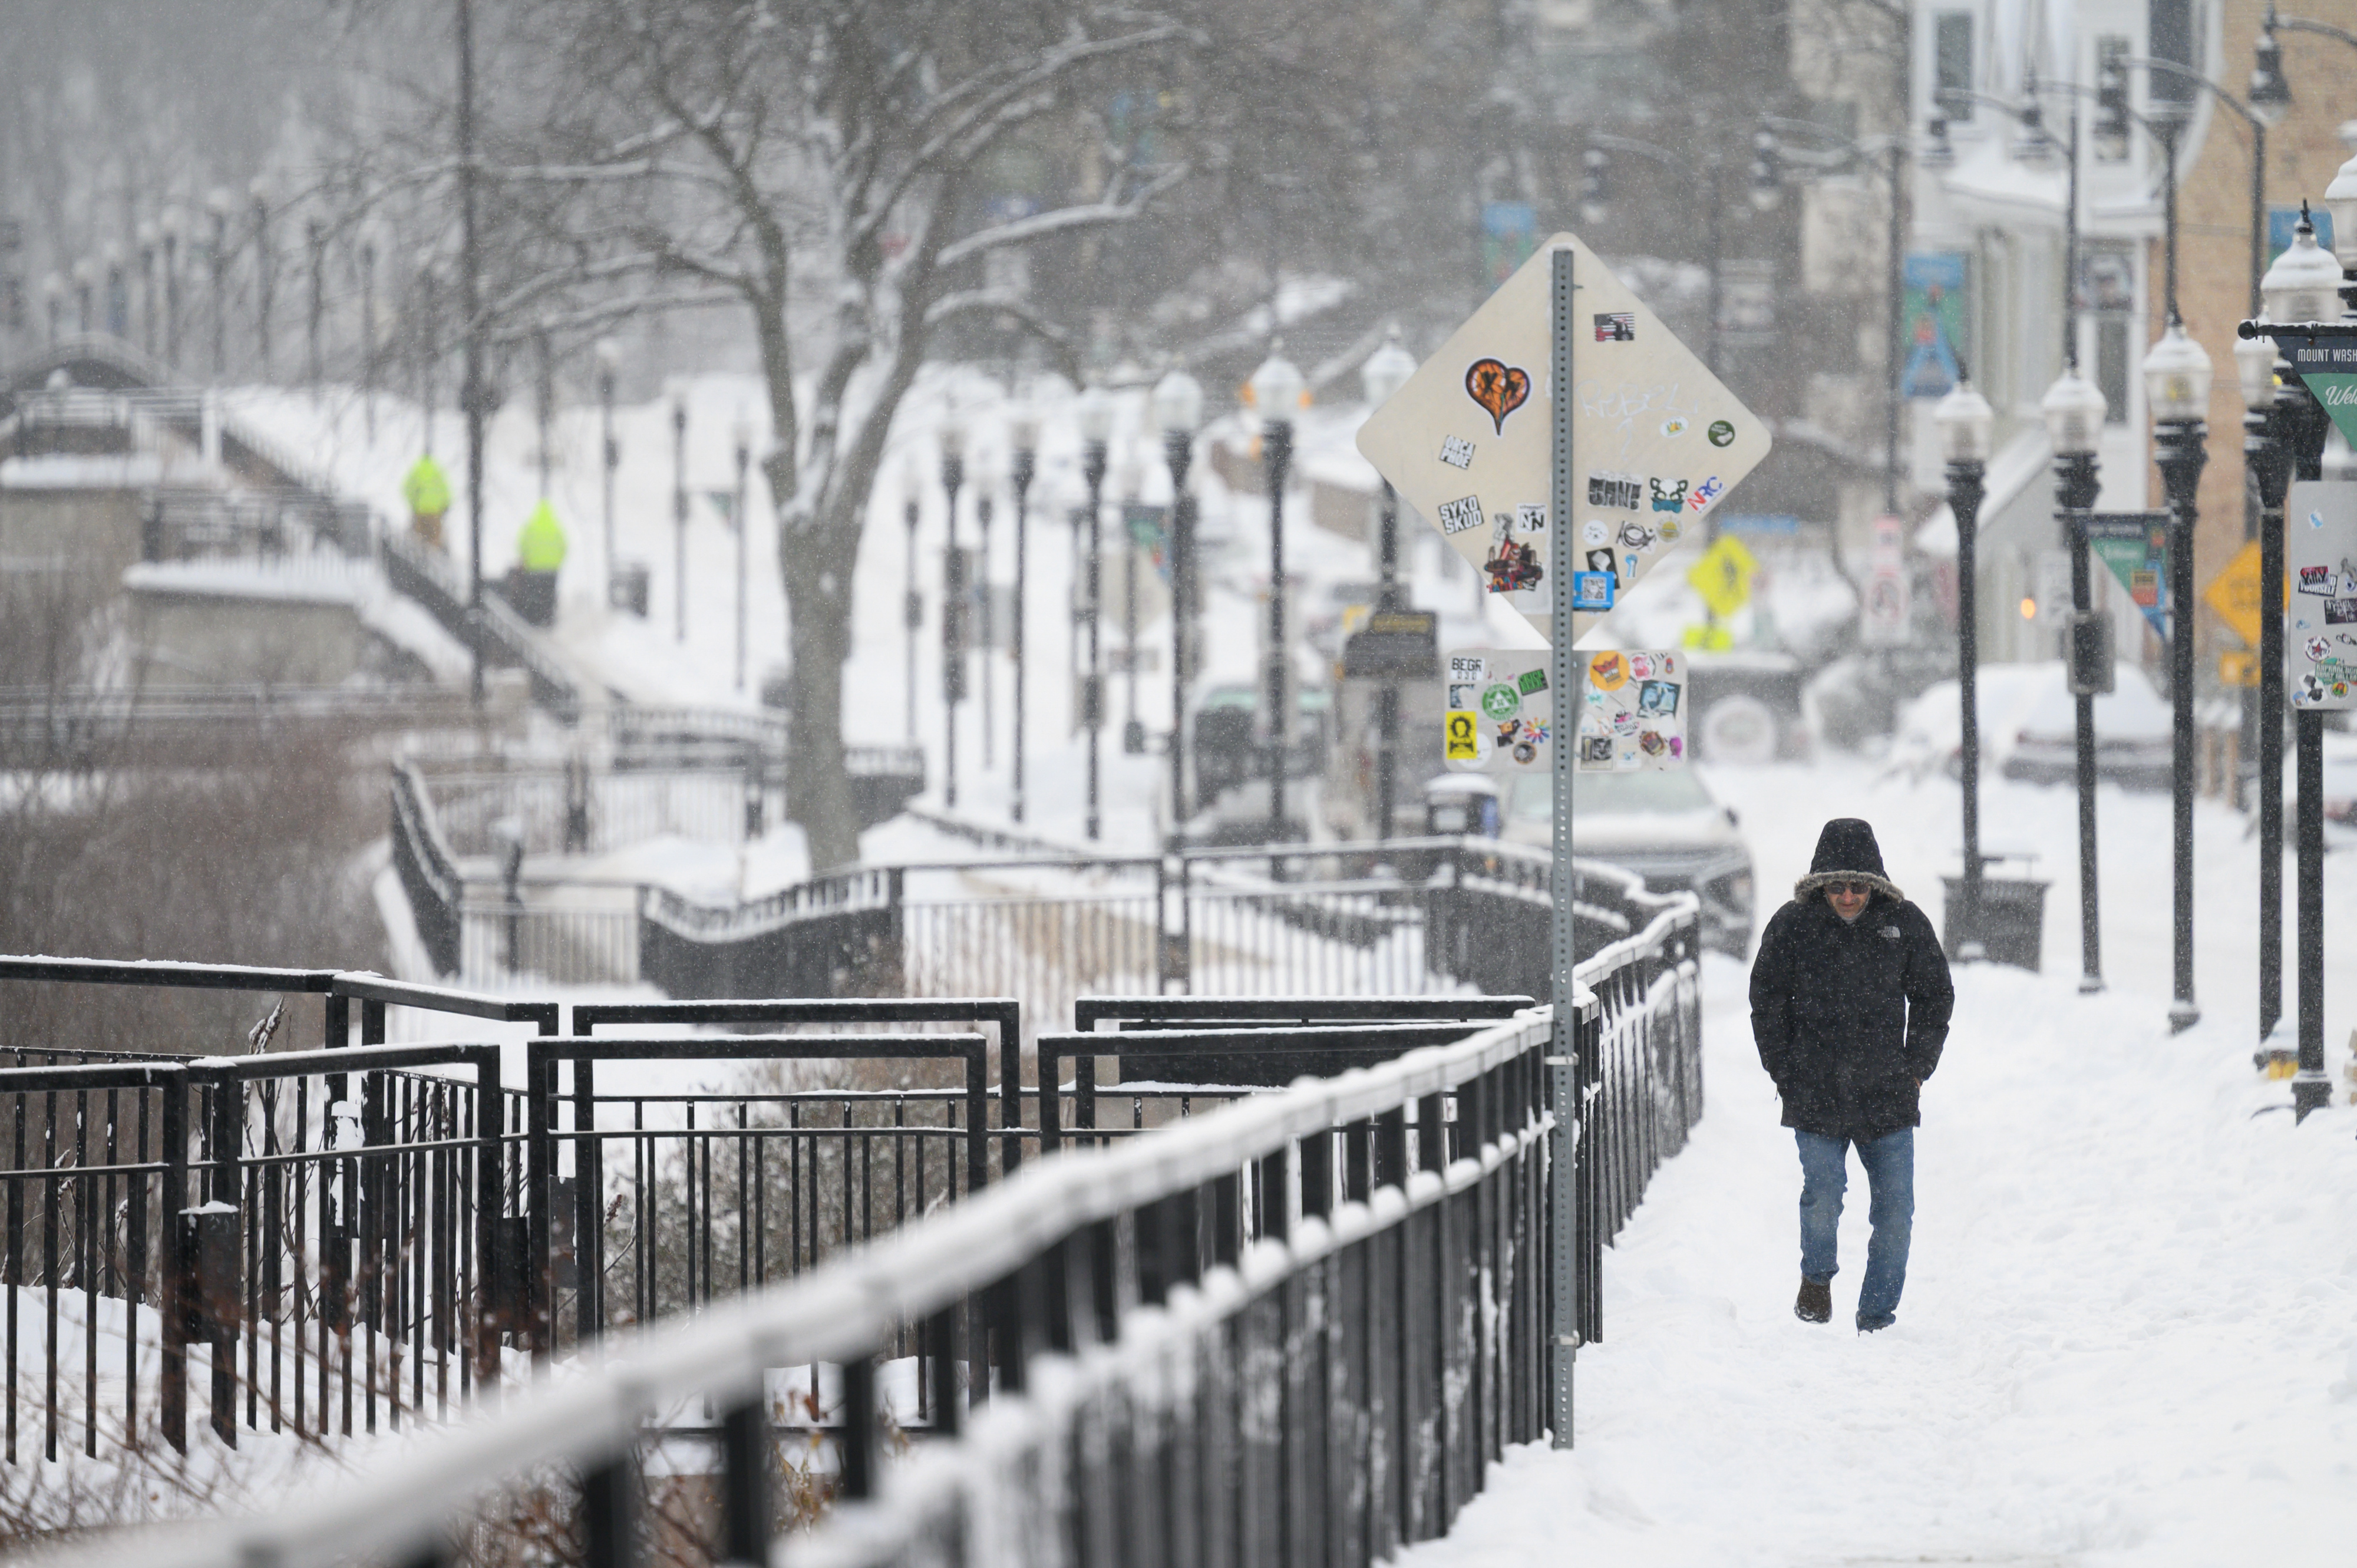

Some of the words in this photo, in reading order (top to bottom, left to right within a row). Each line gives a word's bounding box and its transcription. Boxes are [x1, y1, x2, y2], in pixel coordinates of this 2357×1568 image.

[2297, 349, 2329, 362] MOUNT
[2333, 349, 2357, 362] WASH
[1445, 435, 1474, 457] ORCA
[1440, 447, 1471, 469] PHOE
[1687, 476, 1723, 511] NRC
[1440, 496, 1478, 520] SYKO
[1444, 510, 1483, 535] SKUD
